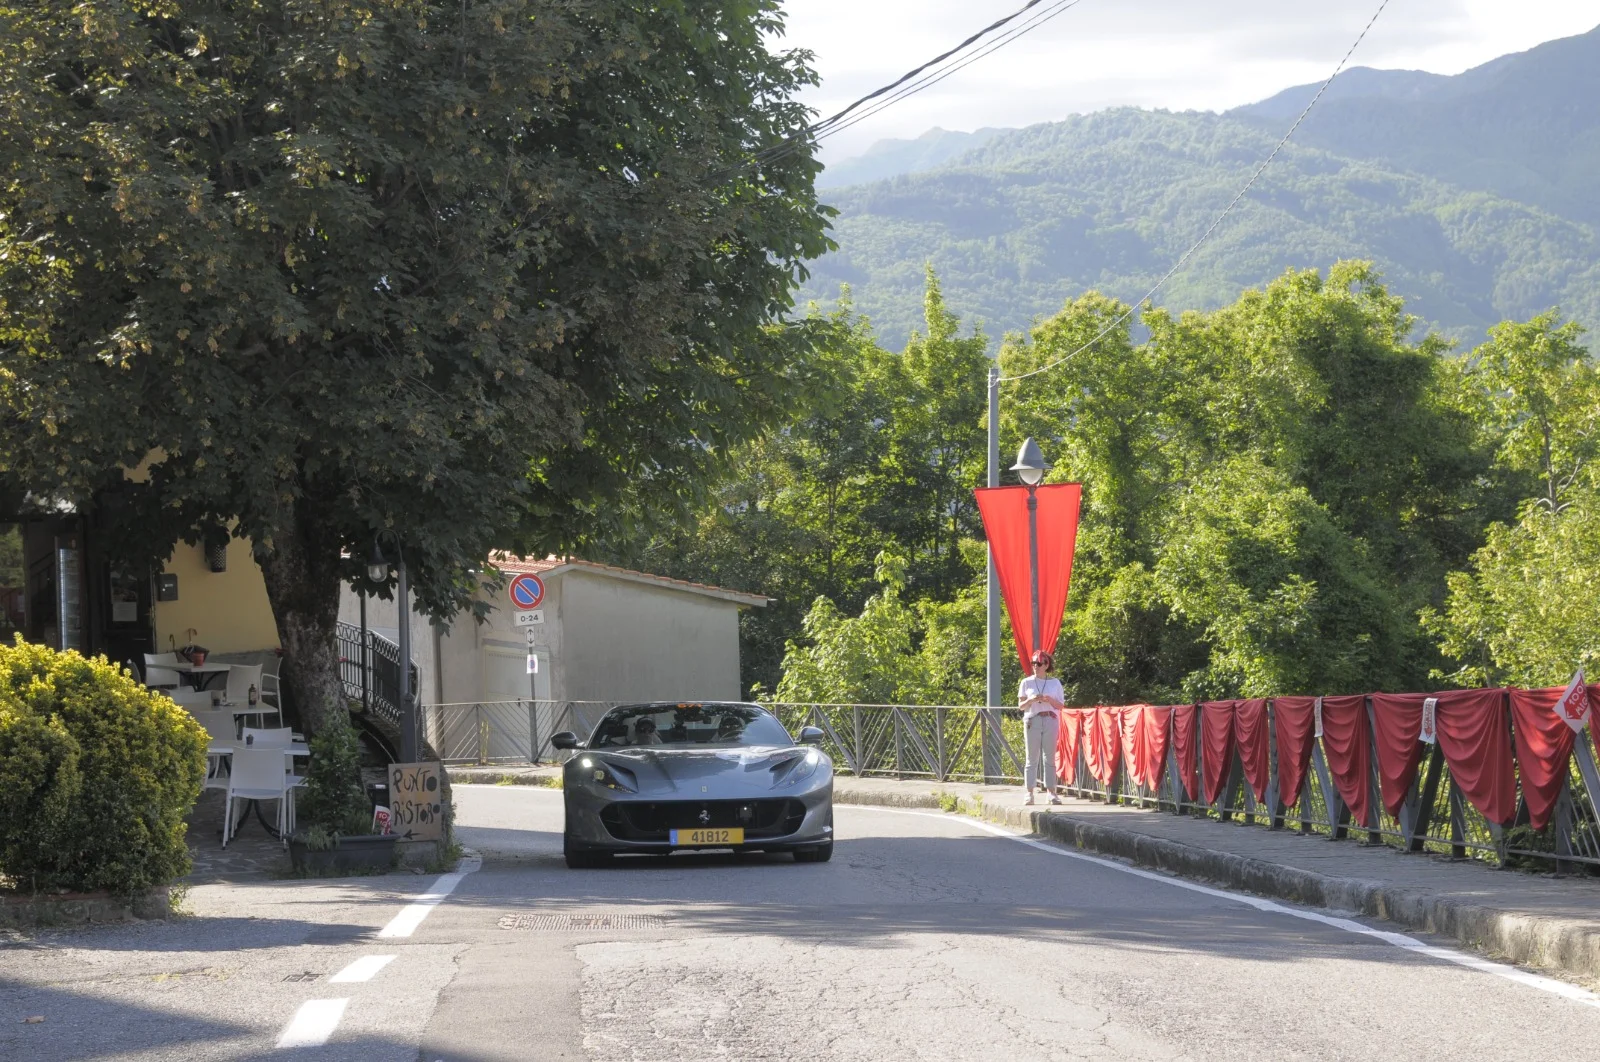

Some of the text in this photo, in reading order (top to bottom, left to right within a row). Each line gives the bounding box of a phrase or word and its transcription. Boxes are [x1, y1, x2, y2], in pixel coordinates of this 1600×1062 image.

[520, 614, 539, 622] 0-24
[393, 768, 437, 793] PUNTO
[691, 830, 729, 843] 41812
